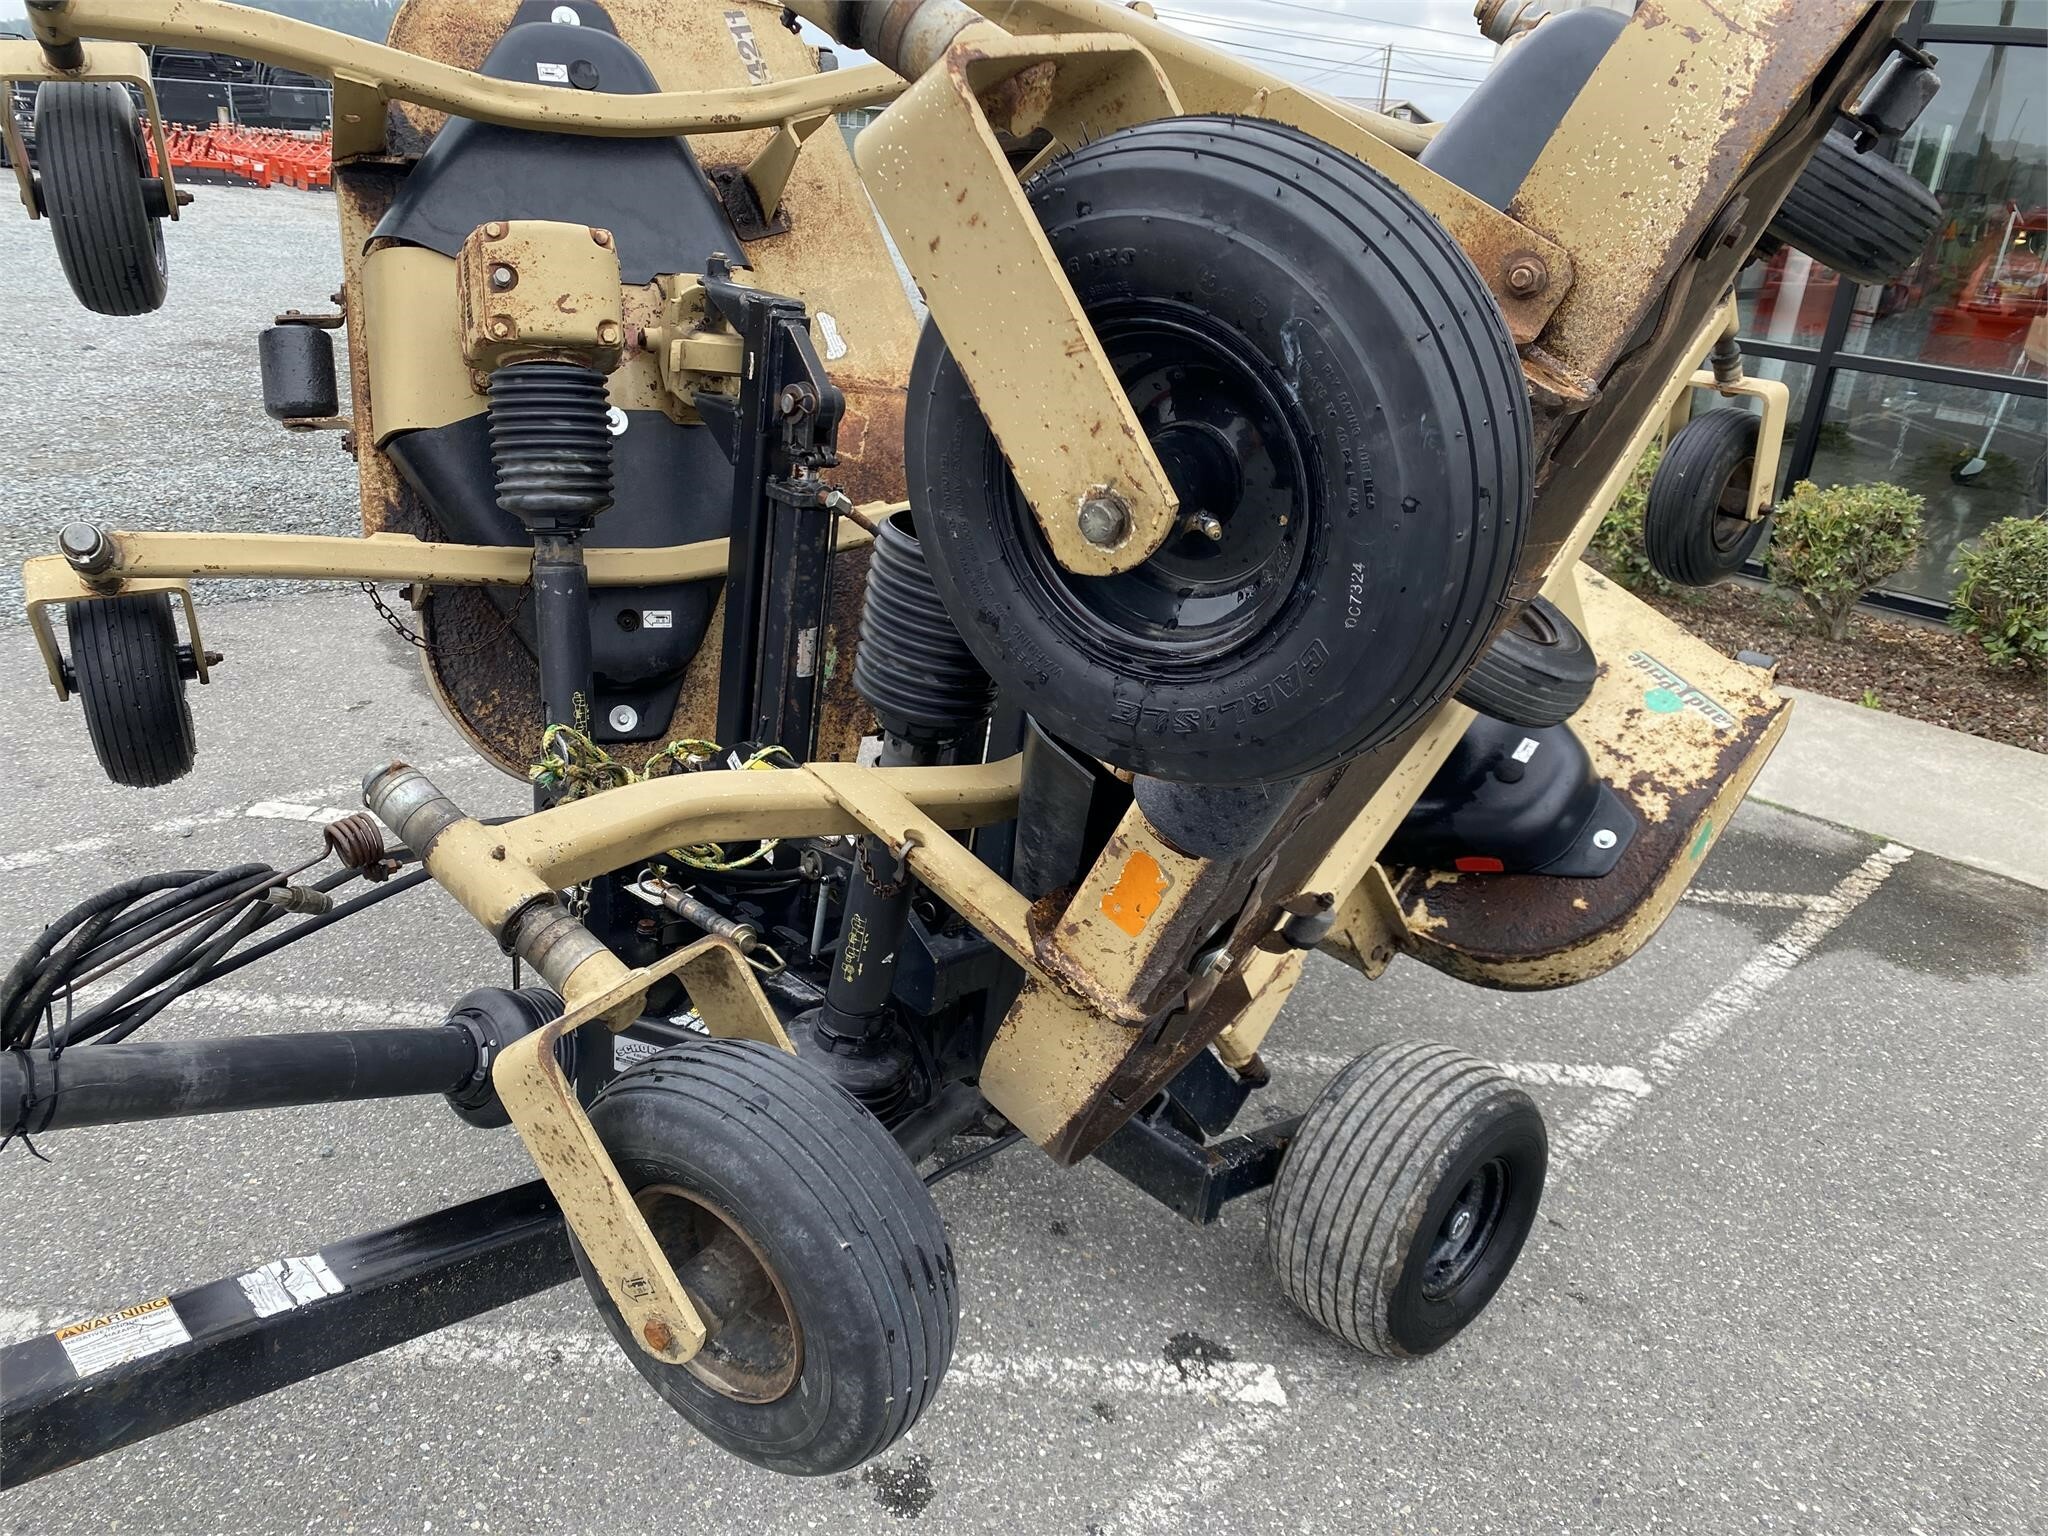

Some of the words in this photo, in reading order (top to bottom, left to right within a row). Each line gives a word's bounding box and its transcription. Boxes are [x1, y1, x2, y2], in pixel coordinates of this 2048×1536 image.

[723, 11, 770, 86] 4211
[1110, 638, 1330, 734] CARLISLE
[616, 1043, 657, 1057] SCHOL
[75, 1300, 167, 1333] WARNING
